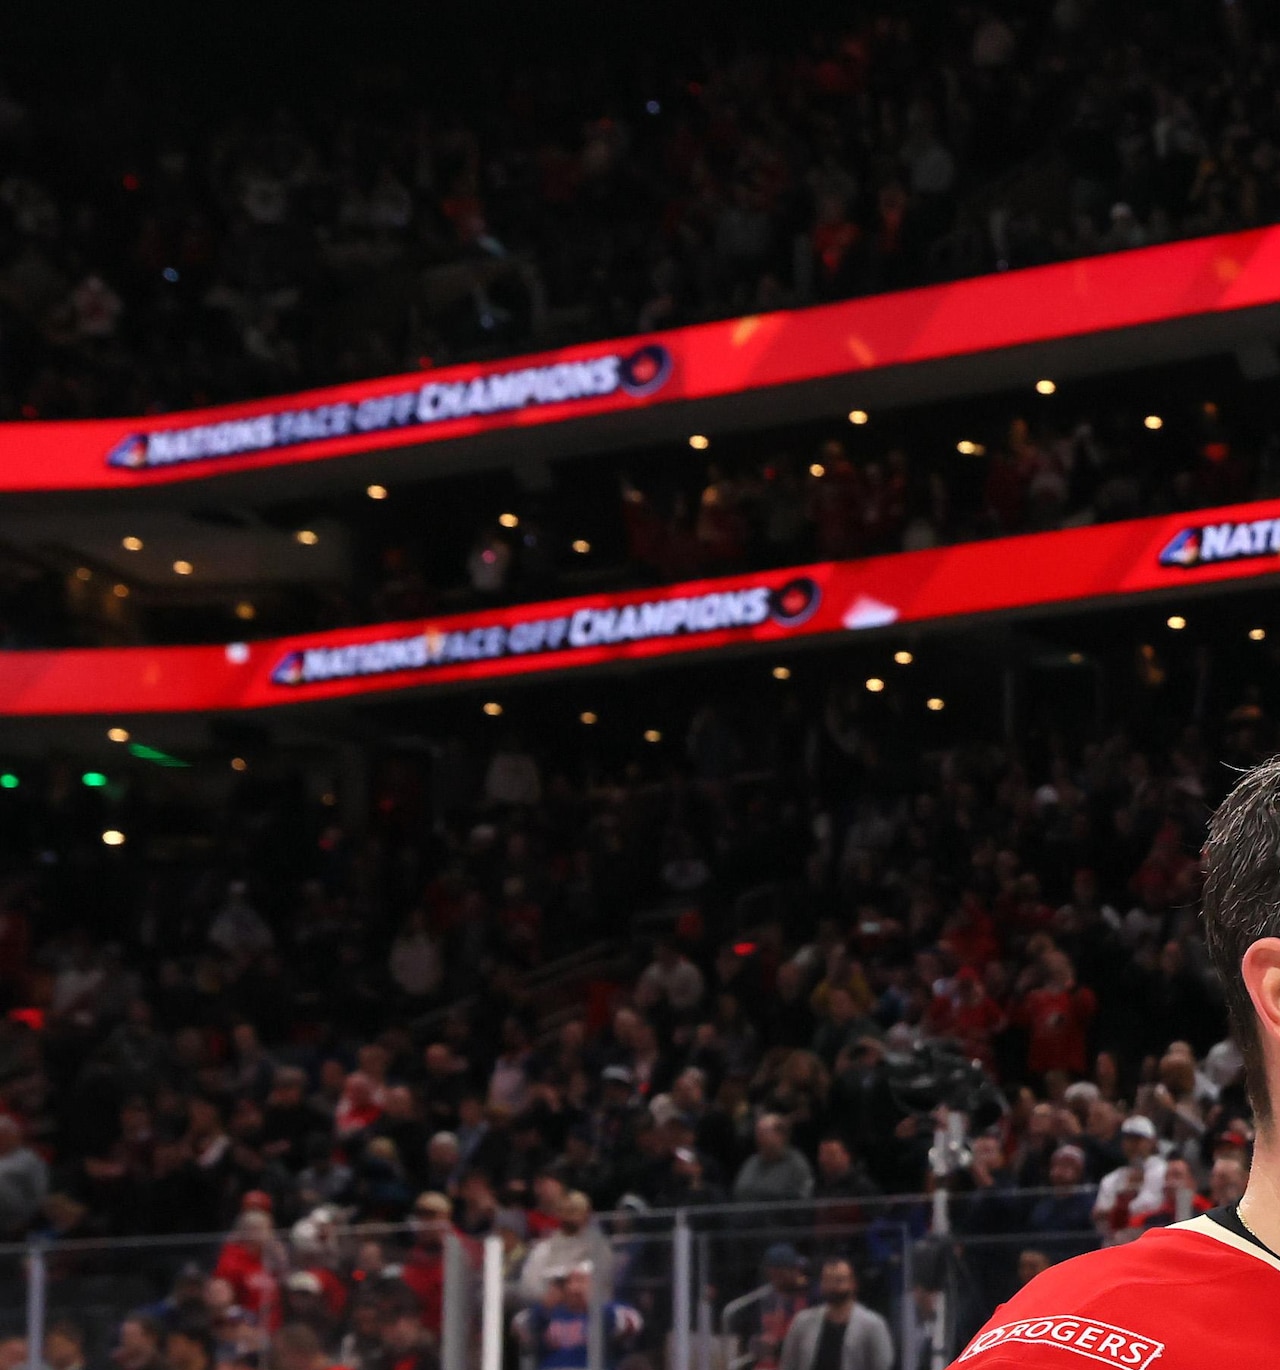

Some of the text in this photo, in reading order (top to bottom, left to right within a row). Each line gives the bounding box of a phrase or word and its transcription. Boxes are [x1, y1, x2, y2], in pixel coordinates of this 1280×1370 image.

[148, 413, 275, 465] NATIONS
[417, 355, 620, 423] CHAMPIONS
[303, 635, 429, 682] NATIONS
[570, 587, 770, 646] CHAMPIONS
[1004, 1321, 1149, 1364] ROGERS
